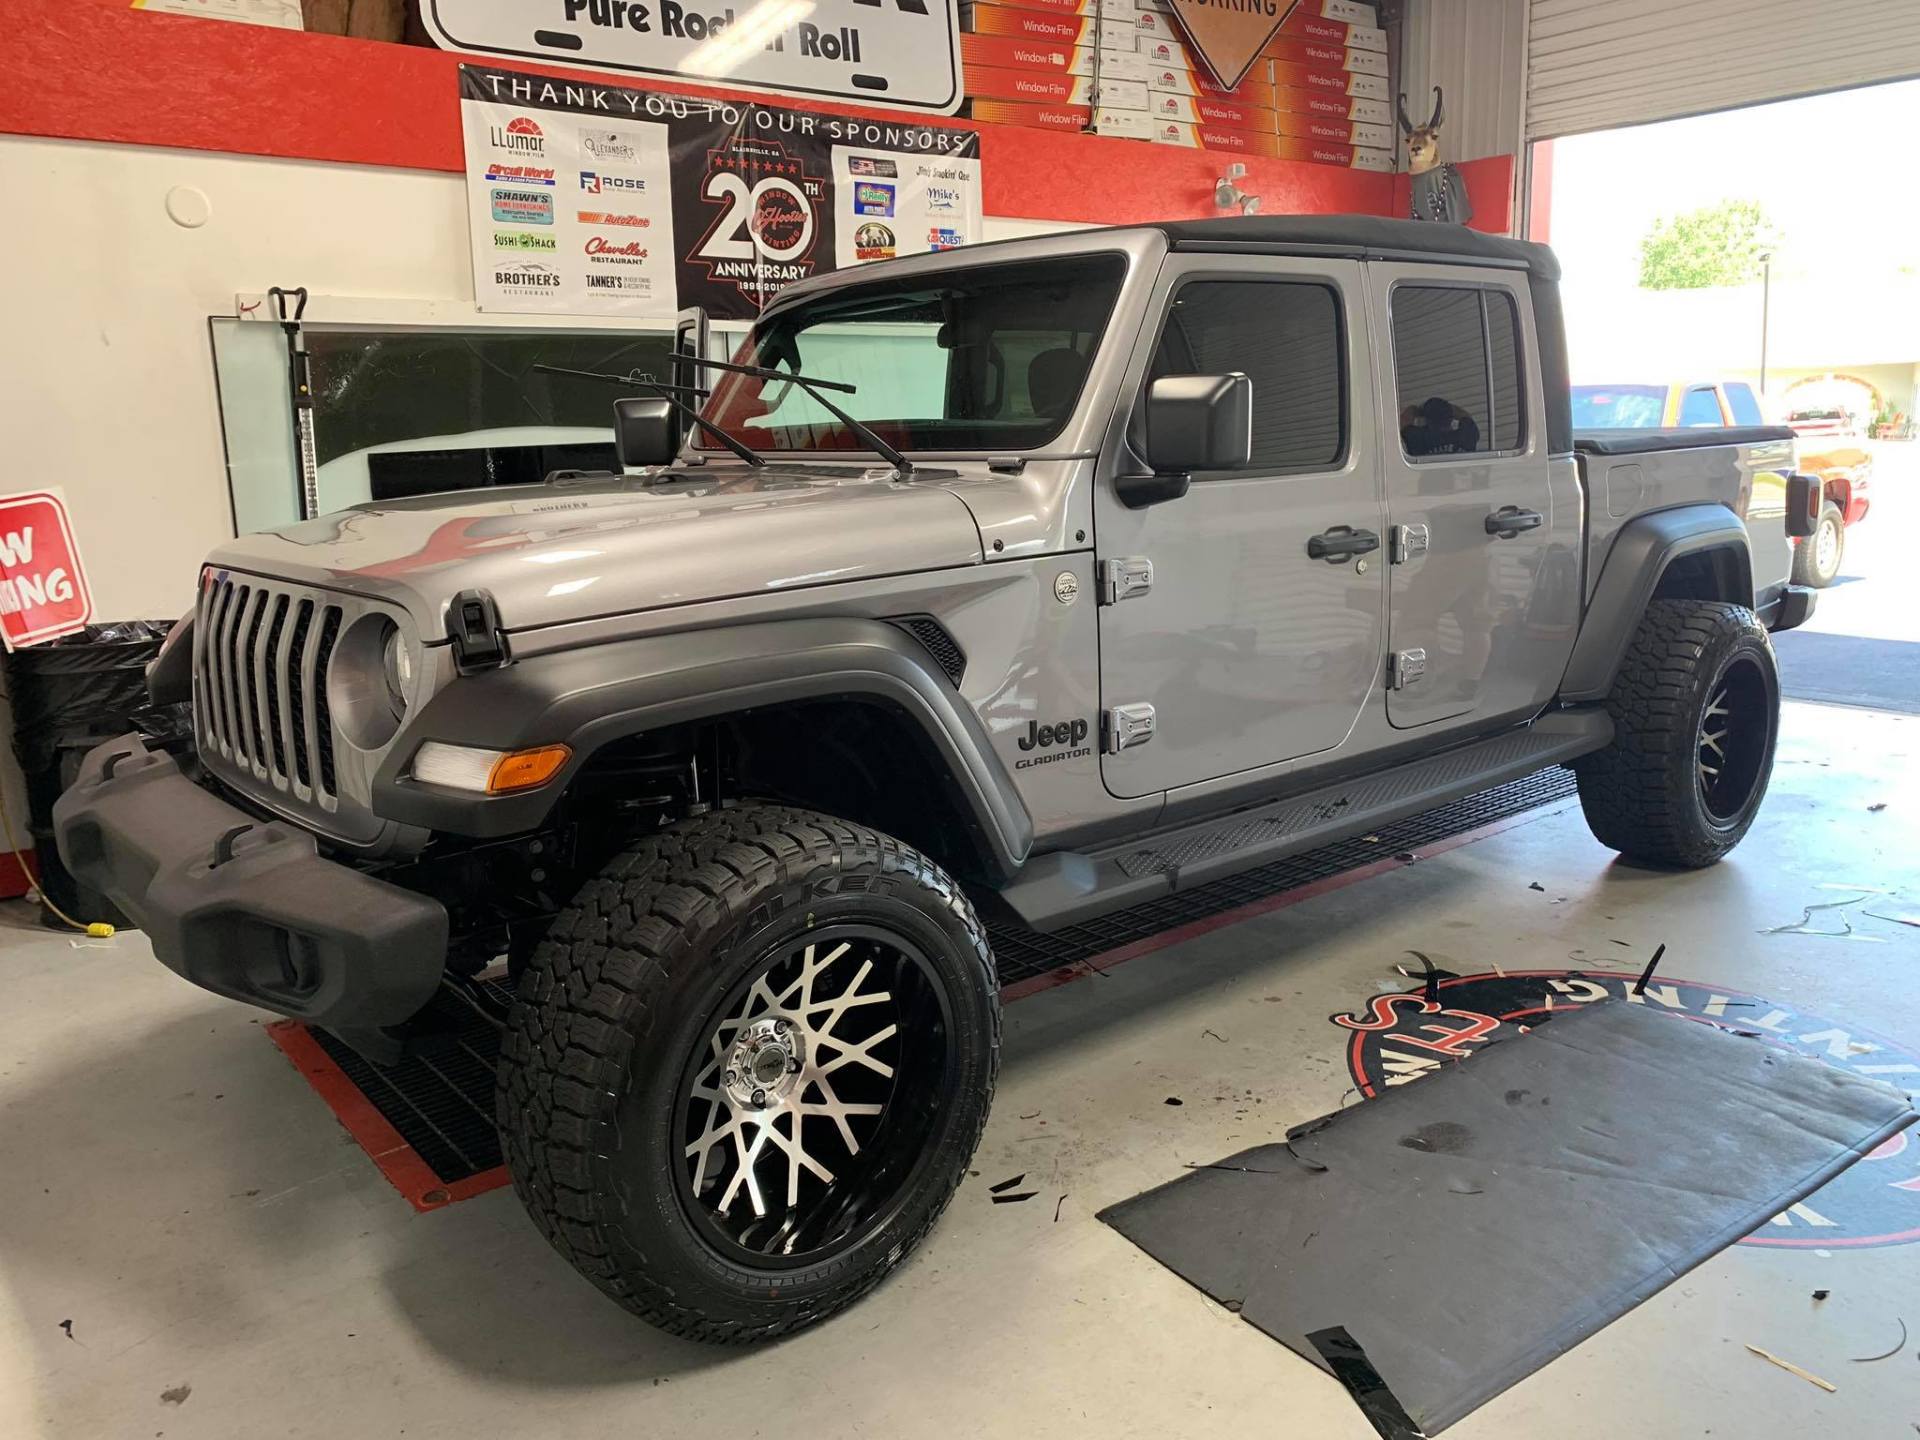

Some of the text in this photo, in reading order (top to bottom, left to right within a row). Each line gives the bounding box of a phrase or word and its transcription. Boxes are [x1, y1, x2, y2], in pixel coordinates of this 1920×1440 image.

[565, 0, 650, 33] Pure
[799, 22, 861, 63] Roll
[1023, 20, 1074, 36] Window Film
[1304, 24, 1343, 38] Window Film
[1014, 50, 1047, 63] Window
[1306, 48, 1343, 61] Window Film
[1015, 81, 1066, 95] Window Film
[1307, 74, 1345, 88] Window Film
[486, 75, 964, 151] THANK YOU TO OUR SPONSORS
[1202, 107, 1242, 121] Window Film
[1309, 101, 1347, 114] Window Film
[1038, 111, 1071, 124] Window
[1071, 115, 1088, 126] Film
[1311, 125, 1348, 138] Window Film
[491, 126, 544, 152] LLumar
[1203, 133, 1244, 146] Window Film
[1313, 150, 1349, 163] Window Film
[524, 167, 555, 179] World
[602, 177, 645, 190] ROSE
[495, 191, 549, 204] SHAWN'S
[604, 213, 650, 228] AutoZone
[494, 233, 556, 249] SUSHI SHACK
[584, 236, 648, 258] Chevelles
[590, 256, 643, 266] RESTAURANT
[715, 261, 807, 280] ANNIVERSARY
[495, 272, 561, 287] BROTHER'S
[586, 274, 623, 289] TANNER'S
[503, 289, 554, 297] RESTAURANT
[1018, 717, 1088, 752] Jeep
[1015, 747, 1091, 770] GLADIATOR
